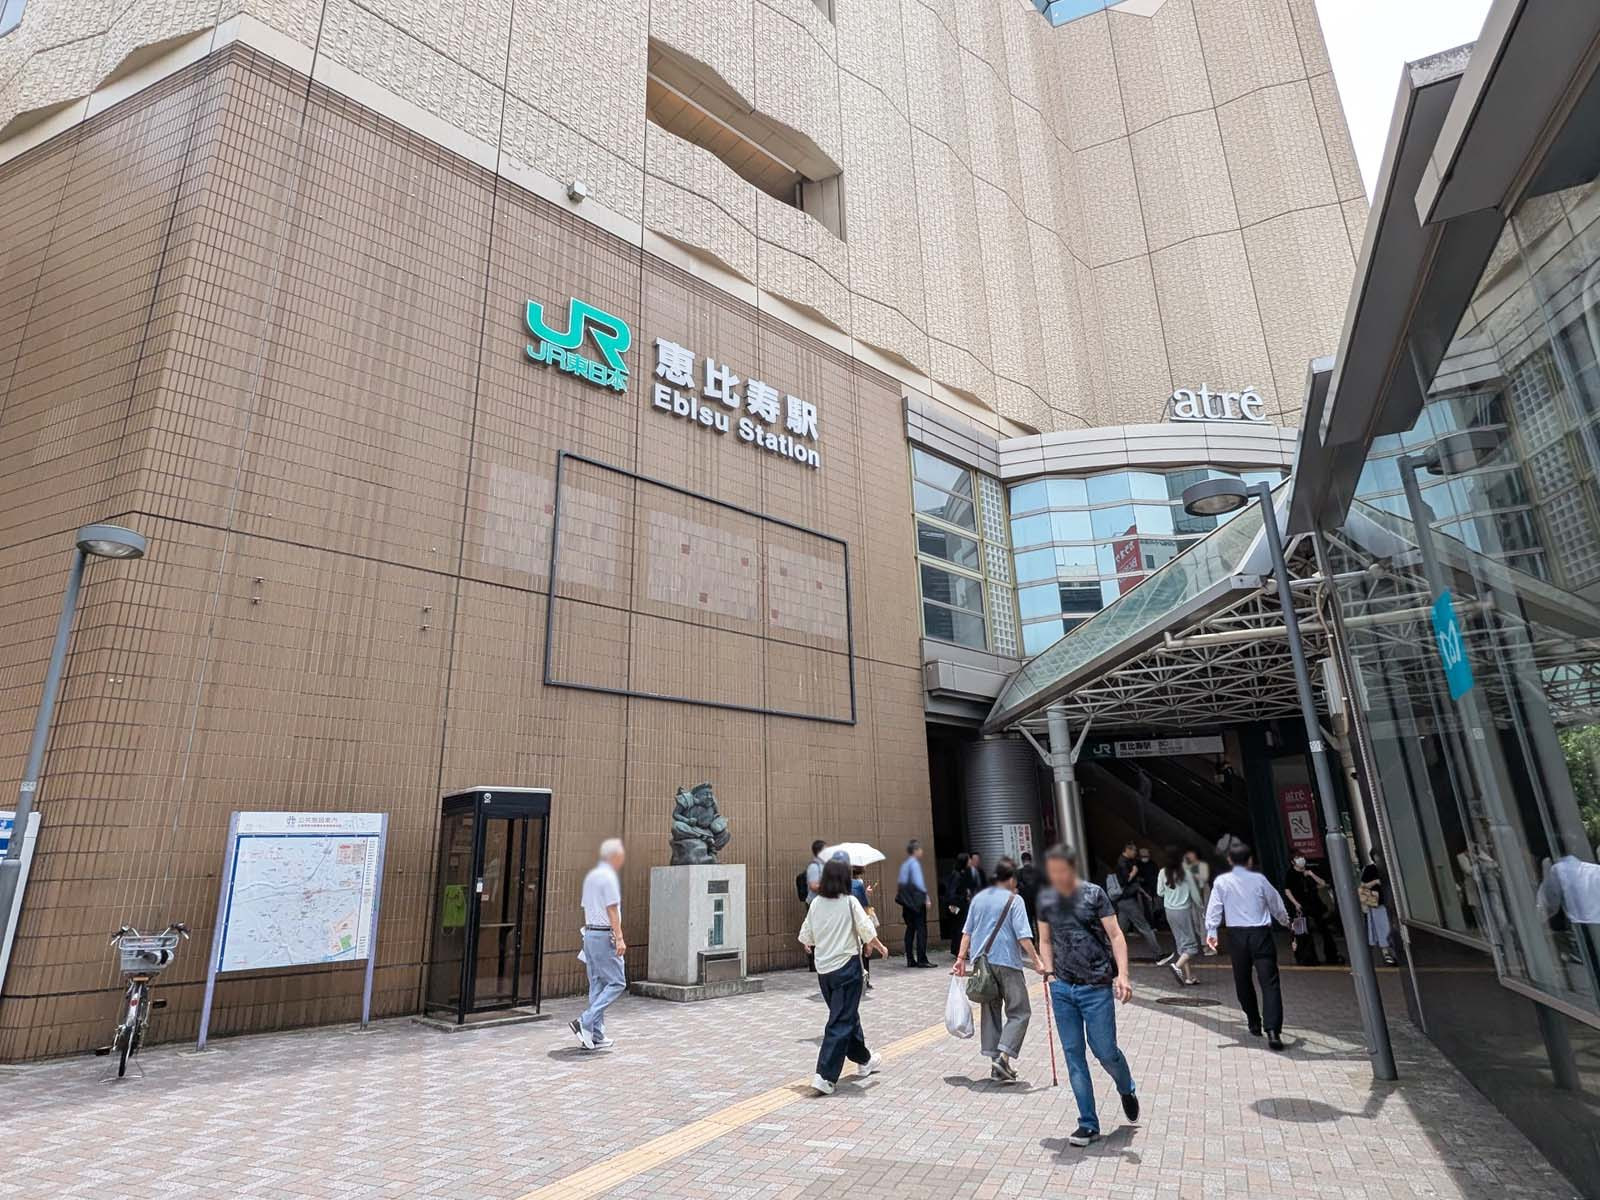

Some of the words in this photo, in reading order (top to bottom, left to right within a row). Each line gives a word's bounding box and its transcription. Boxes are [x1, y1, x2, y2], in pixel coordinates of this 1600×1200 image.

[526, 340, 628, 392] JR東日本
[527, 297, 631, 375] JR
[655, 336, 819, 441] 恵比寿駅
[1172, 383, 1266, 421] atré
[653, 383, 730, 432] Ebisu
[738, 417, 820, 467] Station
[1093, 743, 1112, 754] JR
